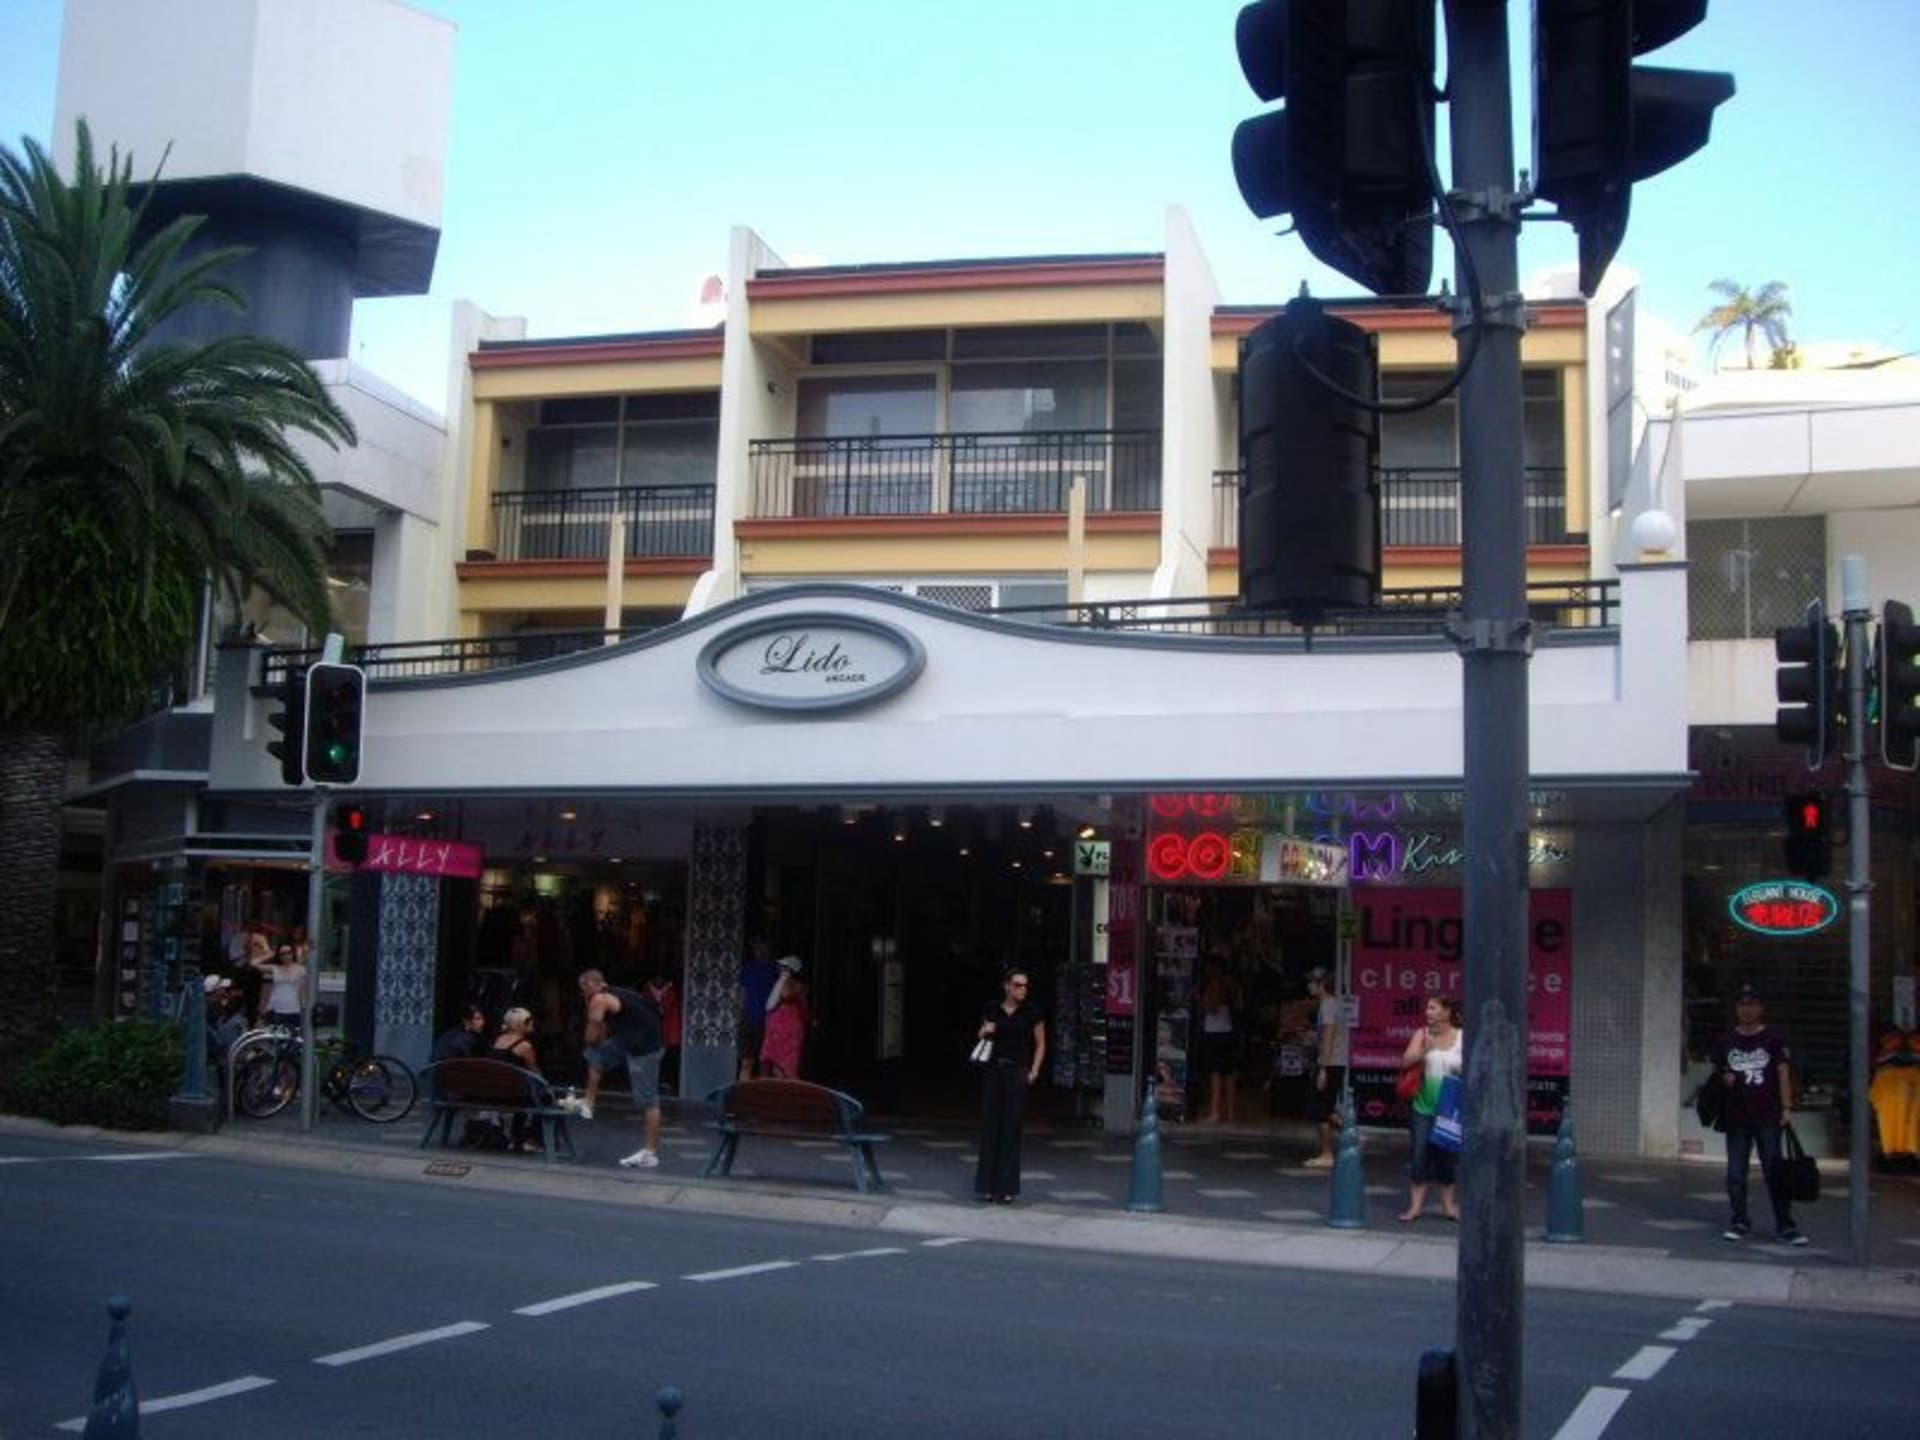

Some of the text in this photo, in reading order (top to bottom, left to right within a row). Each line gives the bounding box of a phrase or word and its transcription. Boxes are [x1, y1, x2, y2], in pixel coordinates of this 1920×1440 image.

[760, 633, 850, 675] Lido
[1149, 830, 1396, 881] CONM
[1362, 906, 1565, 961] Linge
[1107, 968, 1134, 1004] $1
[1360, 963, 1563, 993] cleare
